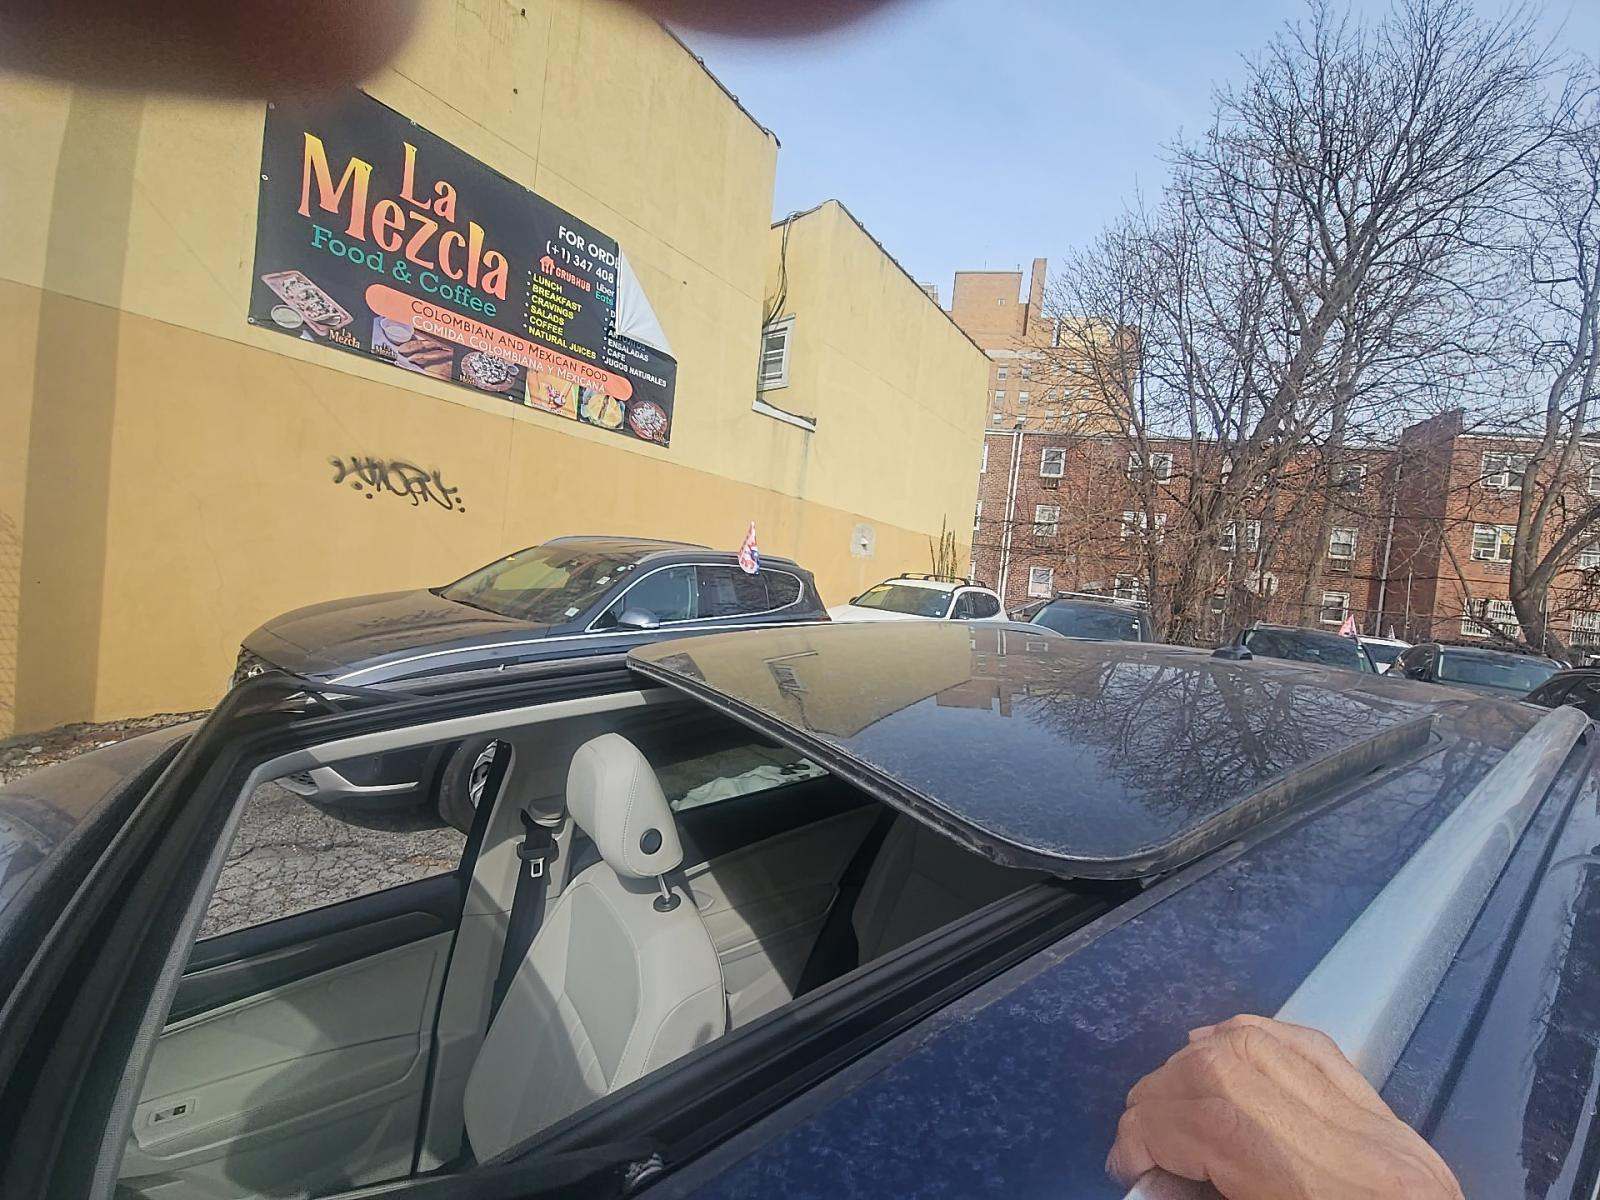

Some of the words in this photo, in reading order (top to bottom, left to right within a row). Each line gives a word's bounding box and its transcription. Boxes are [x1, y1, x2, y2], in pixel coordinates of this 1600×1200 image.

[400, 142, 456, 223] La
[298, 132, 508, 300] Mezcla
[559, 226, 584, 251] FOR
[311, 225, 384, 273] Food
[392, 261, 411, 284] &
[420, 271, 497, 317] Coffee
[547, 240, 570, 263] (+1)
[573, 255, 593, 272] 347
[596, 268, 614, 284] 408
[533, 273, 562, 293] LUNCH
[555, 268, 591, 292] GRUBHUB
[531, 295, 574, 319] CRAVINGS
[532, 284, 582, 312] BREAKFAST
[530, 305, 565, 326] SALADS
[530, 316, 563, 336] COFFEE
[329, 329, 360, 349] Mezcla
[411, 300, 494, 340] COLOMBIAN
[499, 335, 524, 352] AND
[529, 344, 577, 372] MEXICAN
[581, 365, 608, 383] FOOD
[528, 326, 567, 348] NATURAL
[569, 343, 597, 360] JUICES
[608, 338, 649, 362] ENSALADAS
[412, 315, 465, 344] COMIDA
[470, 335, 543, 372] COLOMBIANA
[557, 367, 606, 393] MEXICANA
[607, 349, 626, 362] CAFE
[604, 357, 628, 373] JUGOS
[629, 367, 667, 387] NATURALES
